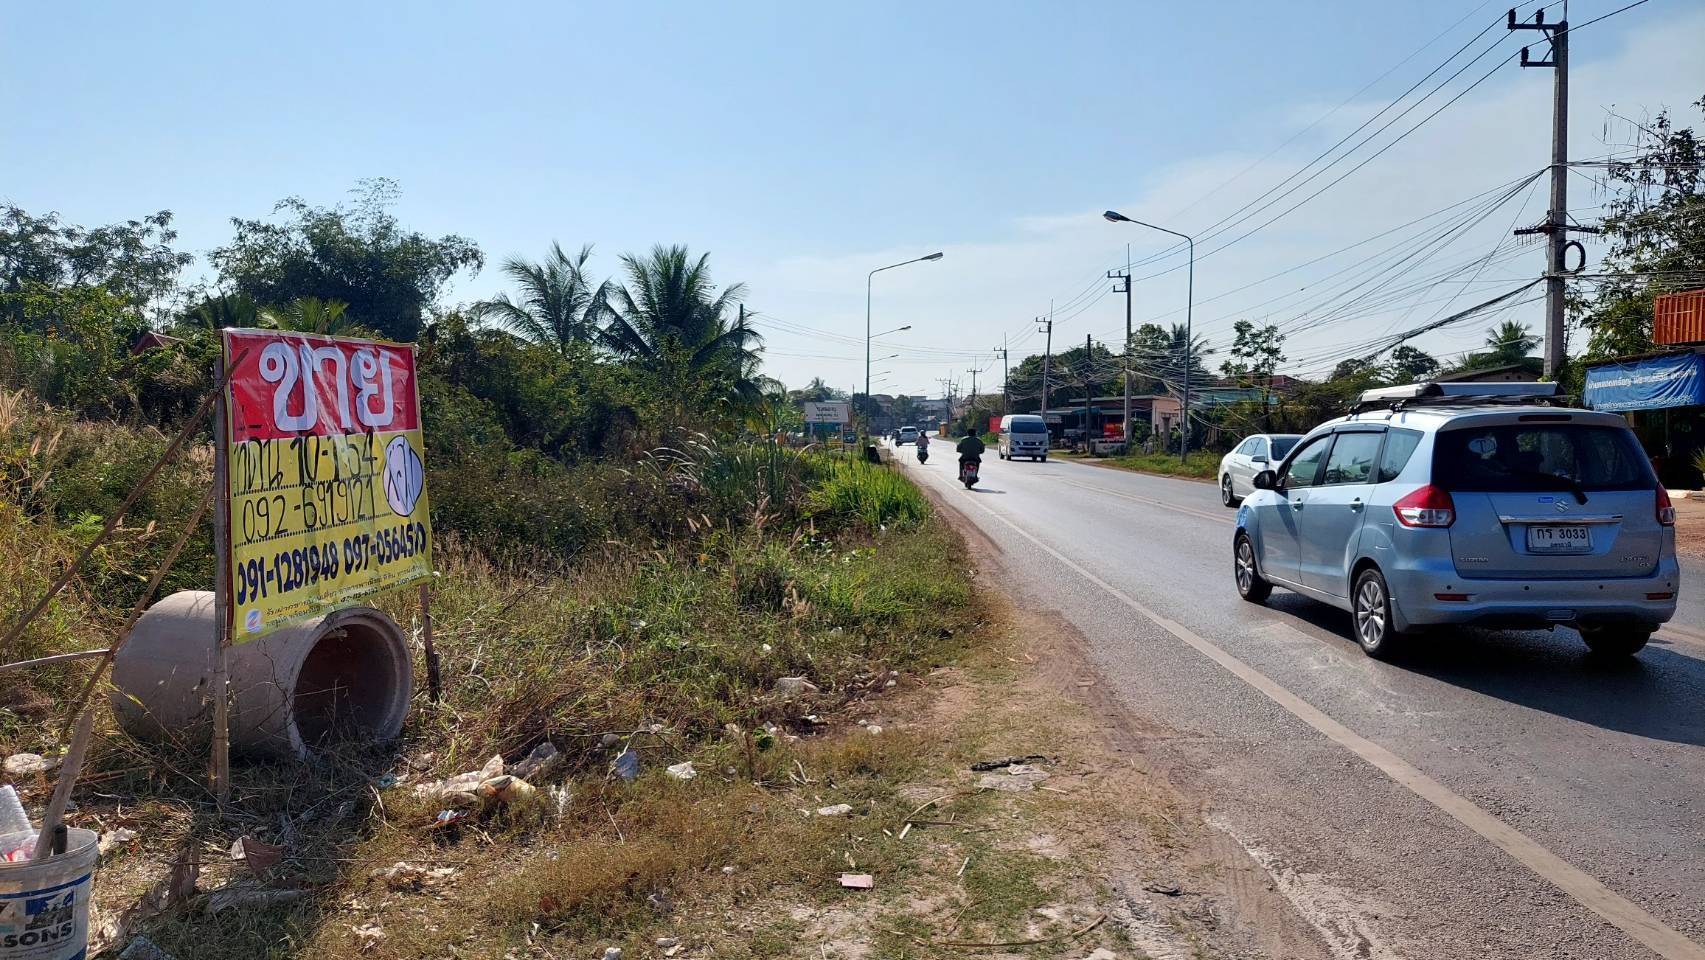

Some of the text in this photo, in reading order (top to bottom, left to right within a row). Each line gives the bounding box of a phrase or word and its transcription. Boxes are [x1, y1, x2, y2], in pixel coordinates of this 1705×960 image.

[258, 341, 394, 432] ขาย
[243, 476, 375, 542] 092-6919121
[1559, 528, 1586, 540] 3033
[237, 541, 339, 606] 091-1281948
